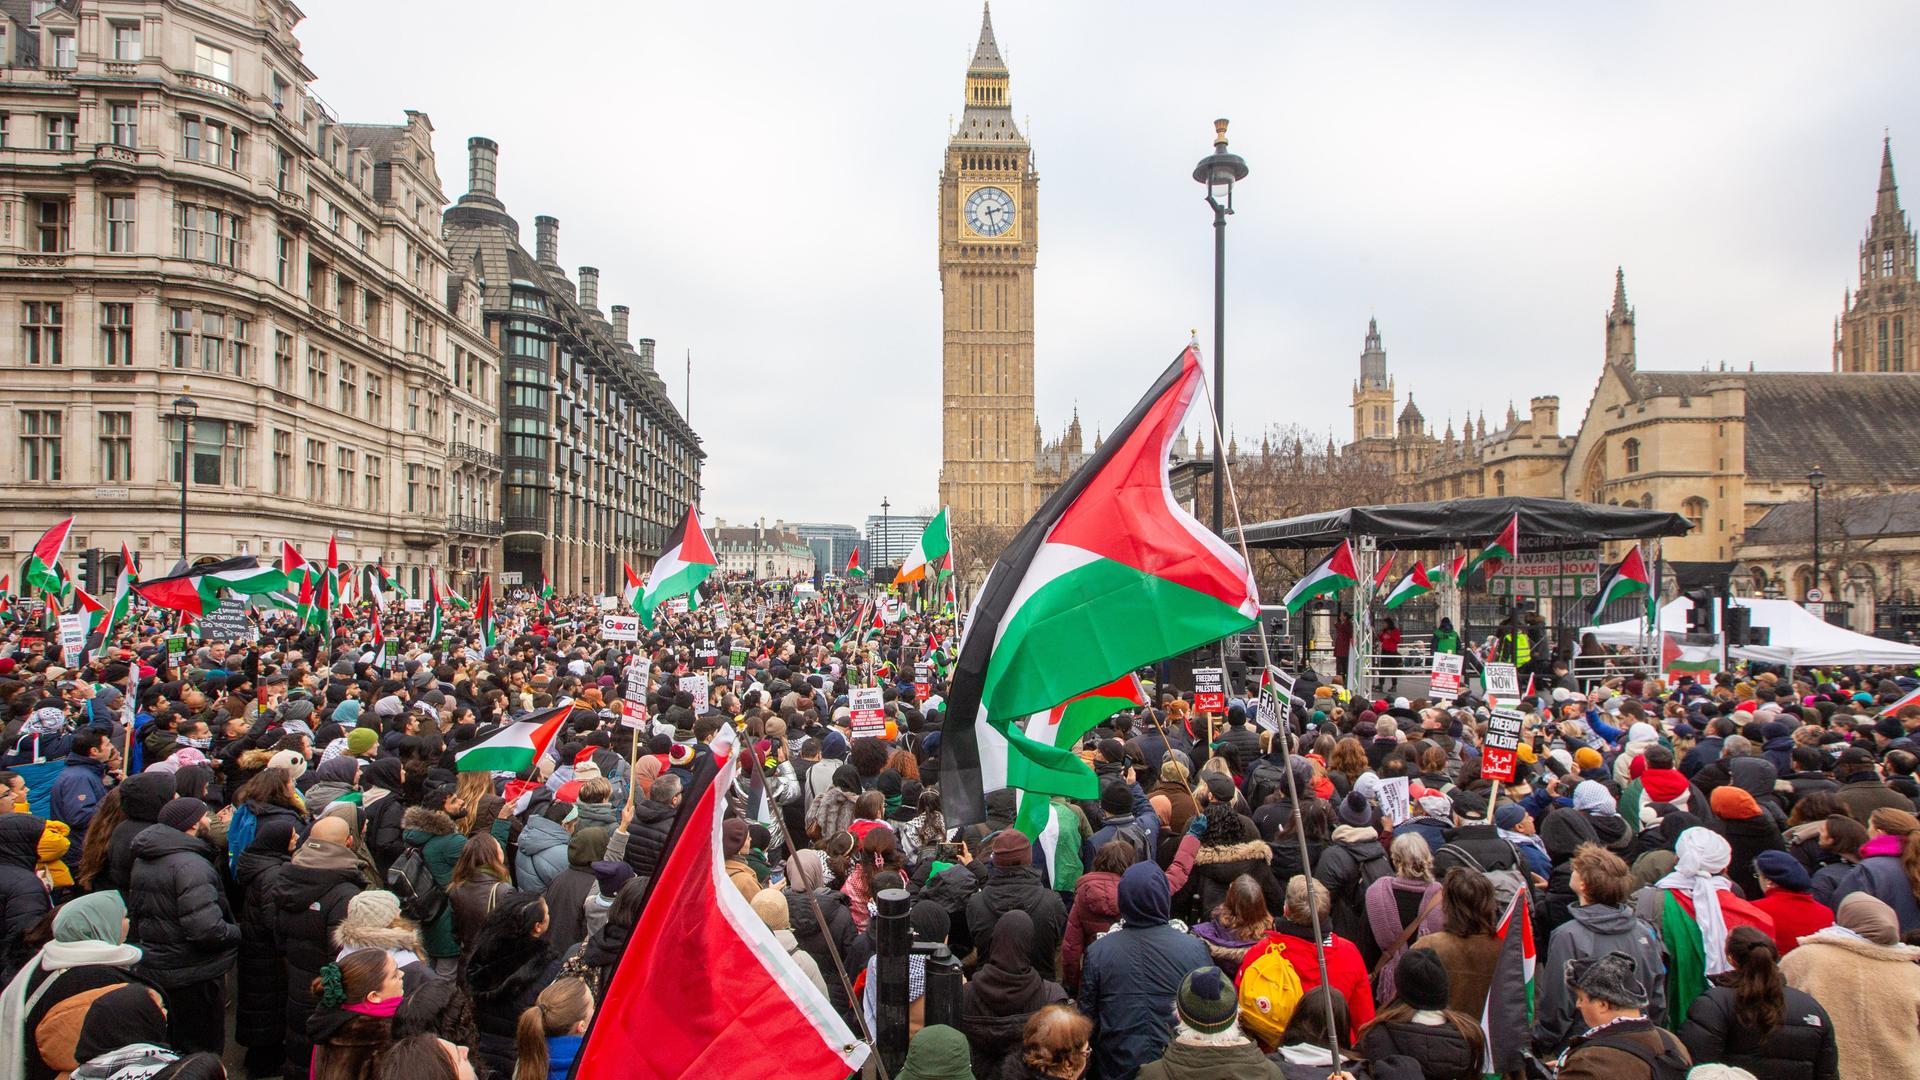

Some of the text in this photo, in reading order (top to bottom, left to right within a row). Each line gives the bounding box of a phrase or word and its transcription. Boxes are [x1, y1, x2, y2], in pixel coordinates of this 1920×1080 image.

[1521, 553, 1546, 565] WAR
[1564, 550, 1597, 561] GAZA
[1502, 564, 1559, 576] CEASEFIRE
[703, 639, 716, 648] Fre
[1195, 674, 1220, 682] FREEDOM
[1486, 667, 1515, 677] CEASEFIRE
[1195, 685, 1223, 693] PALESTINE
[1491, 676, 1515, 689] NOW!
[1260, 689, 1288, 721] FRE
[1259, 703, 1287, 727] PALESTE
[1490, 716, 1521, 733] FREEDOM
[1485, 732, 1519, 750] PALESTINE
